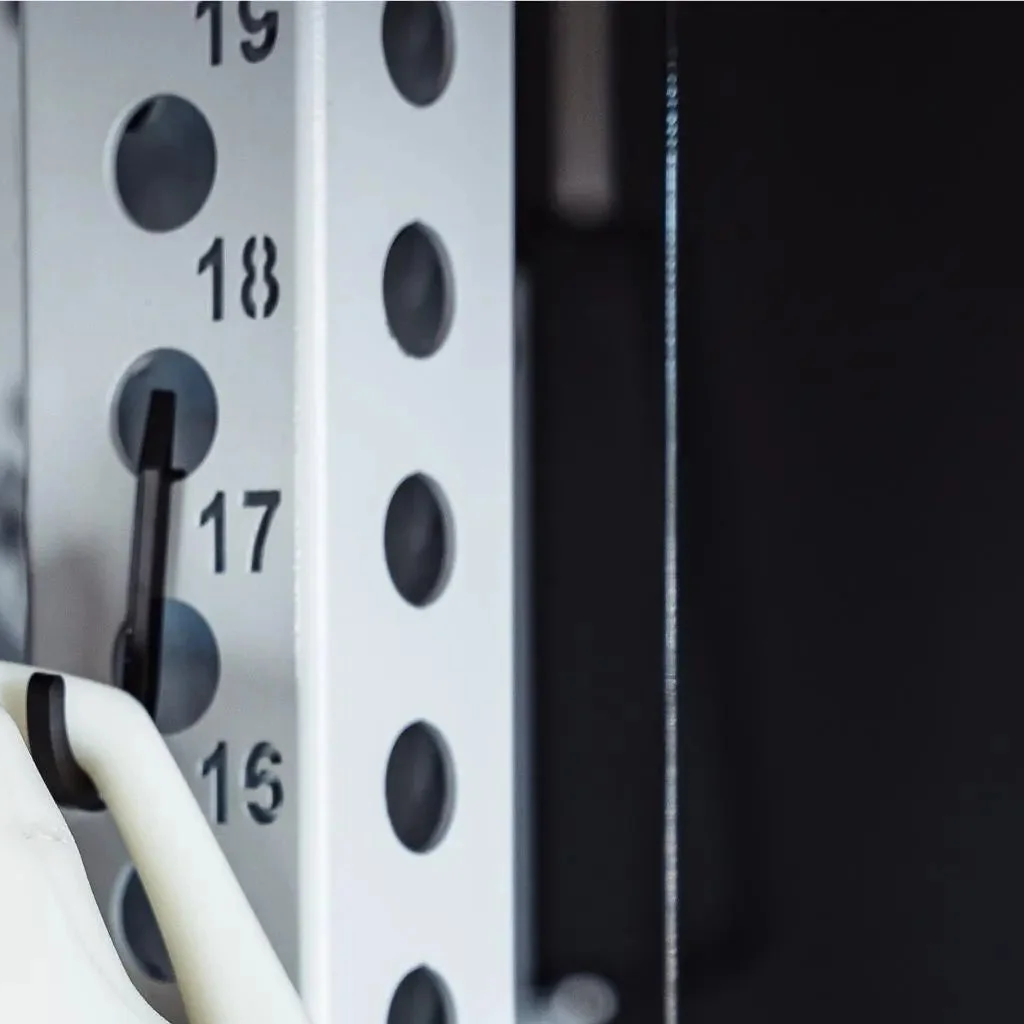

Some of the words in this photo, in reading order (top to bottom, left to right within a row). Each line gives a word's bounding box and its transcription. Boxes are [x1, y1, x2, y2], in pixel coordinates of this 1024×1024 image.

[195, 0, 279, 66] 19
[197, 234, 280, 322] 18
[199, 489, 281, 574] 17
[201, 740, 284, 825] 16
